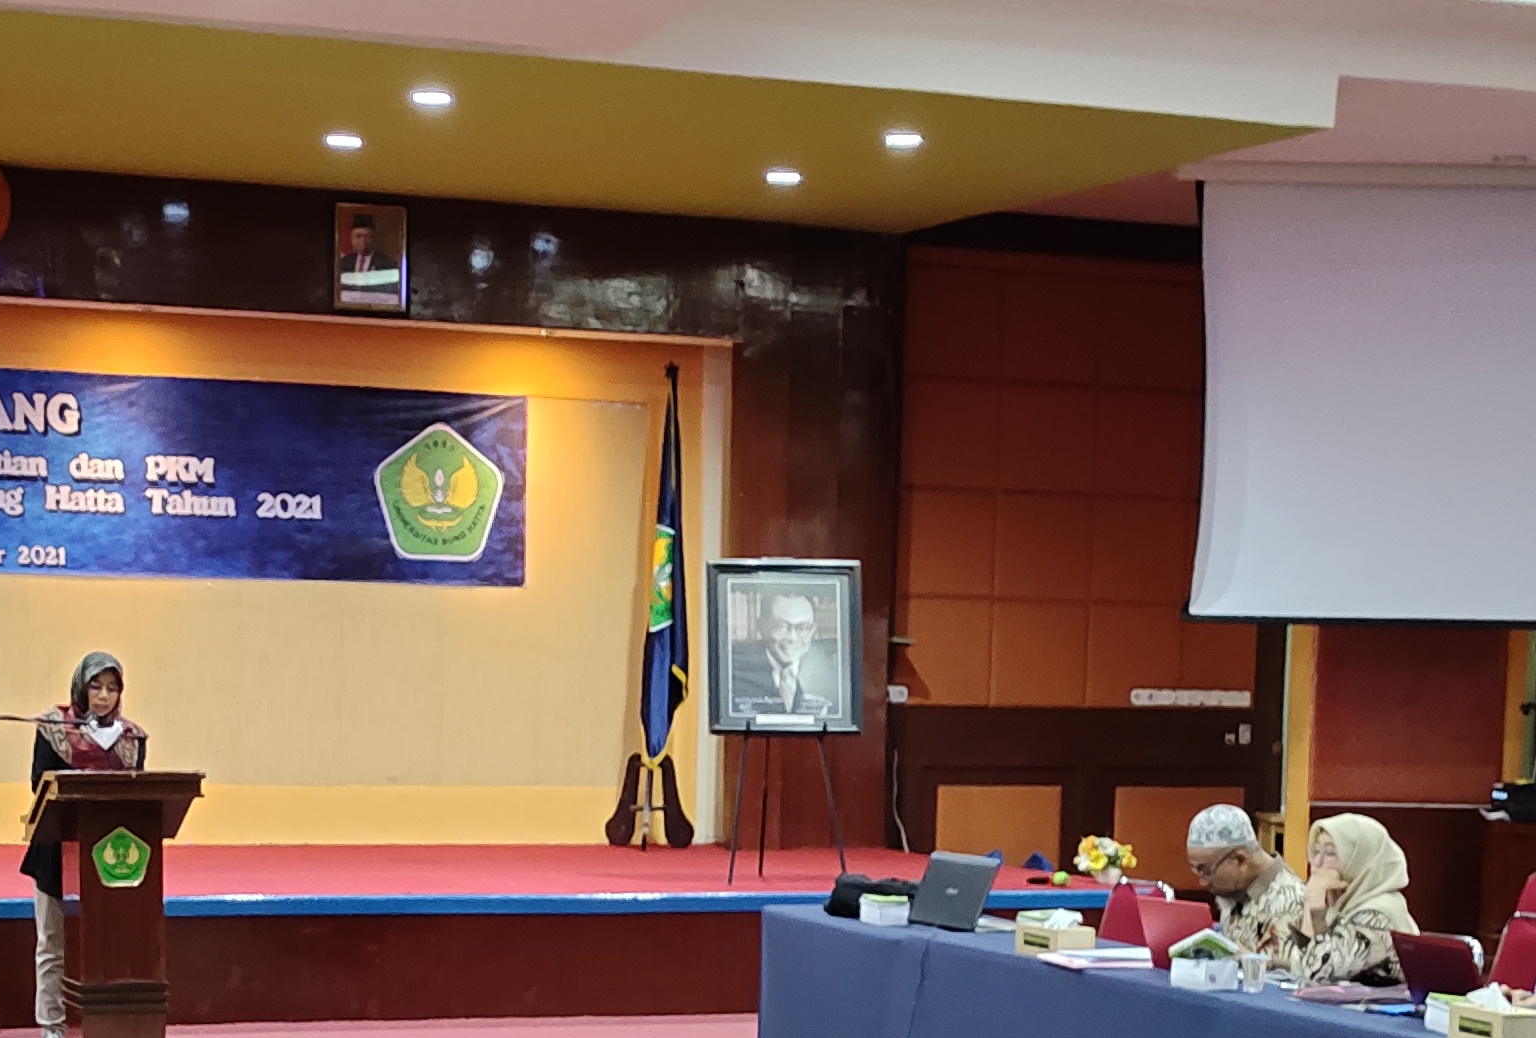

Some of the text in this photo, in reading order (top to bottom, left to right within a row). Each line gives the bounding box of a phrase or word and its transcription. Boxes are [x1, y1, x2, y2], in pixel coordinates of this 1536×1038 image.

[68, 452, 126, 481] dan
[145, 454, 215, 484] PKM
[44, 484, 126, 514] Hatta
[145, 487, 237, 518] Tahun
[255, 492, 323, 520] 2021
[17, 544, 67, 567] 2021
